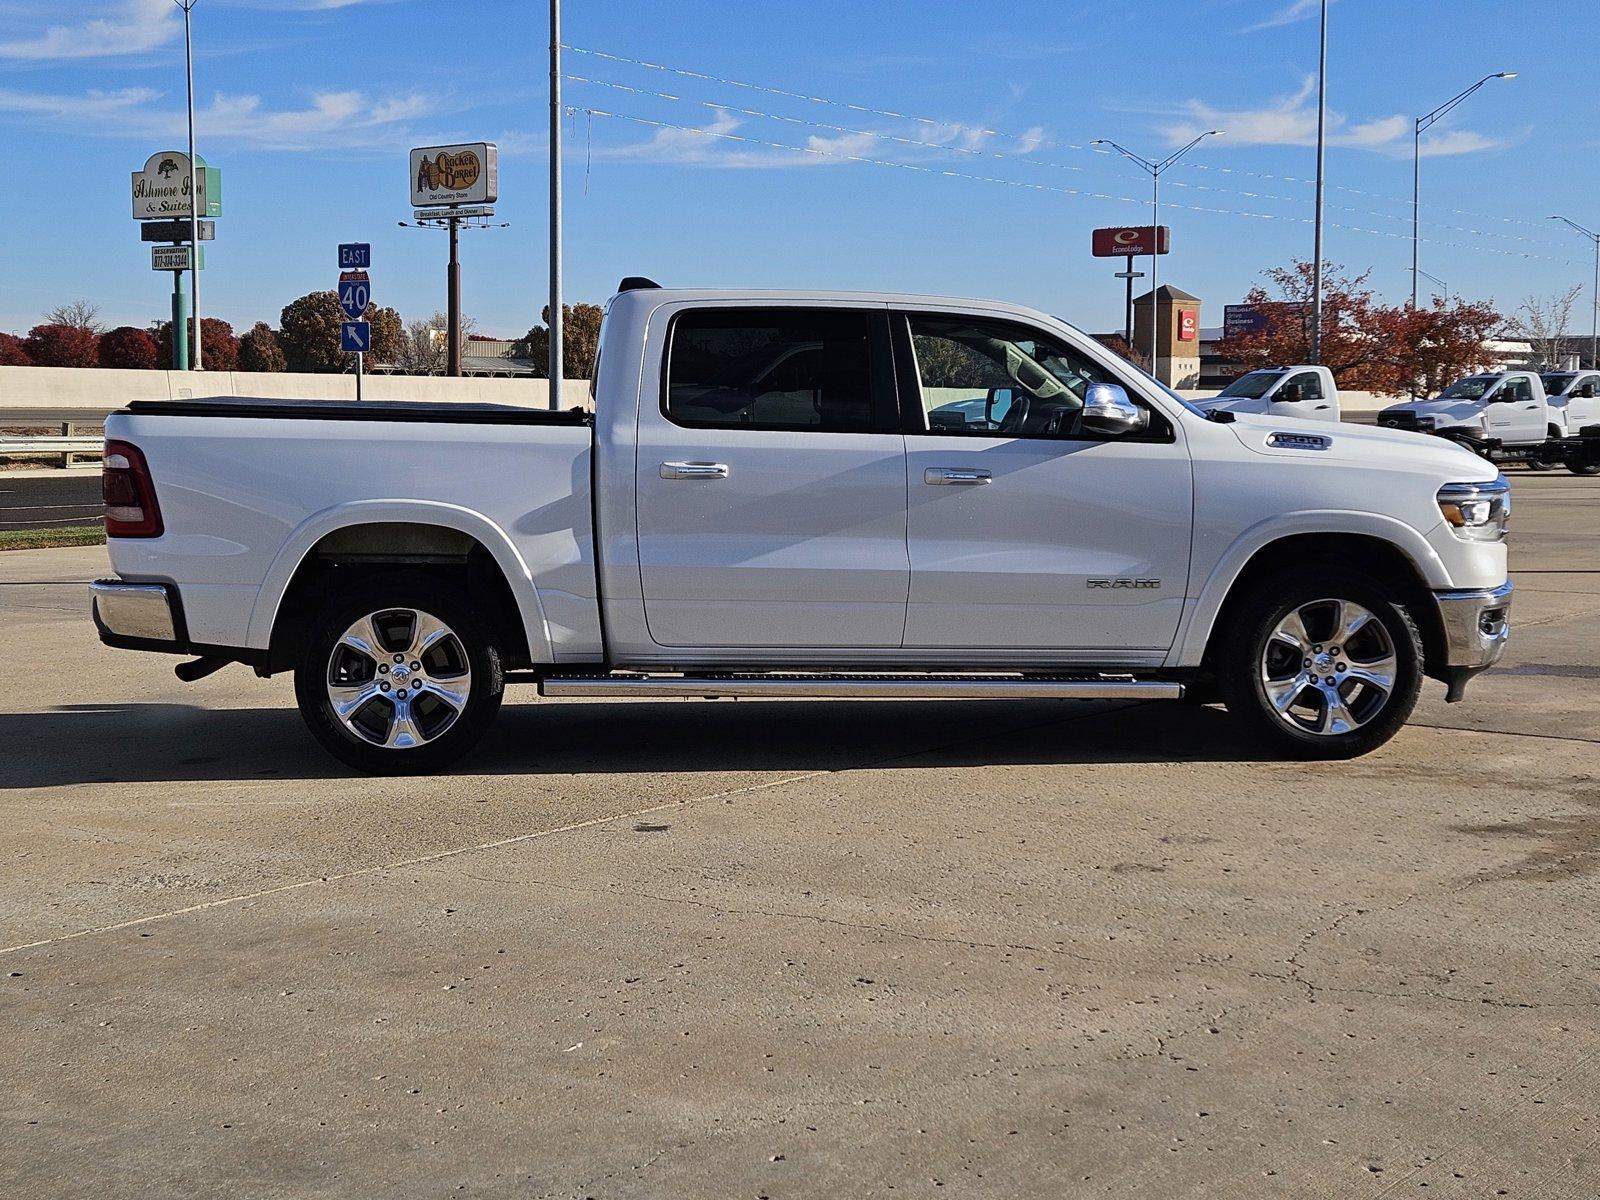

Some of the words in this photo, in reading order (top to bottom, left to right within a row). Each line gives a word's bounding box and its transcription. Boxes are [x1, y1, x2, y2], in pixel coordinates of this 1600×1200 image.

[437, 153, 475, 173] Cracker
[444, 166, 477, 188] Barrel
[134, 178, 178, 198] Ashmore
[429, 193, 437, 201] Old
[438, 192, 455, 200] Country
[146, 201, 156, 213] &
[158, 200, 192, 213] Suites
[342, 248, 366, 264] EAST
[342, 285, 367, 310] 40
[1087, 578, 1160, 588] RAM
